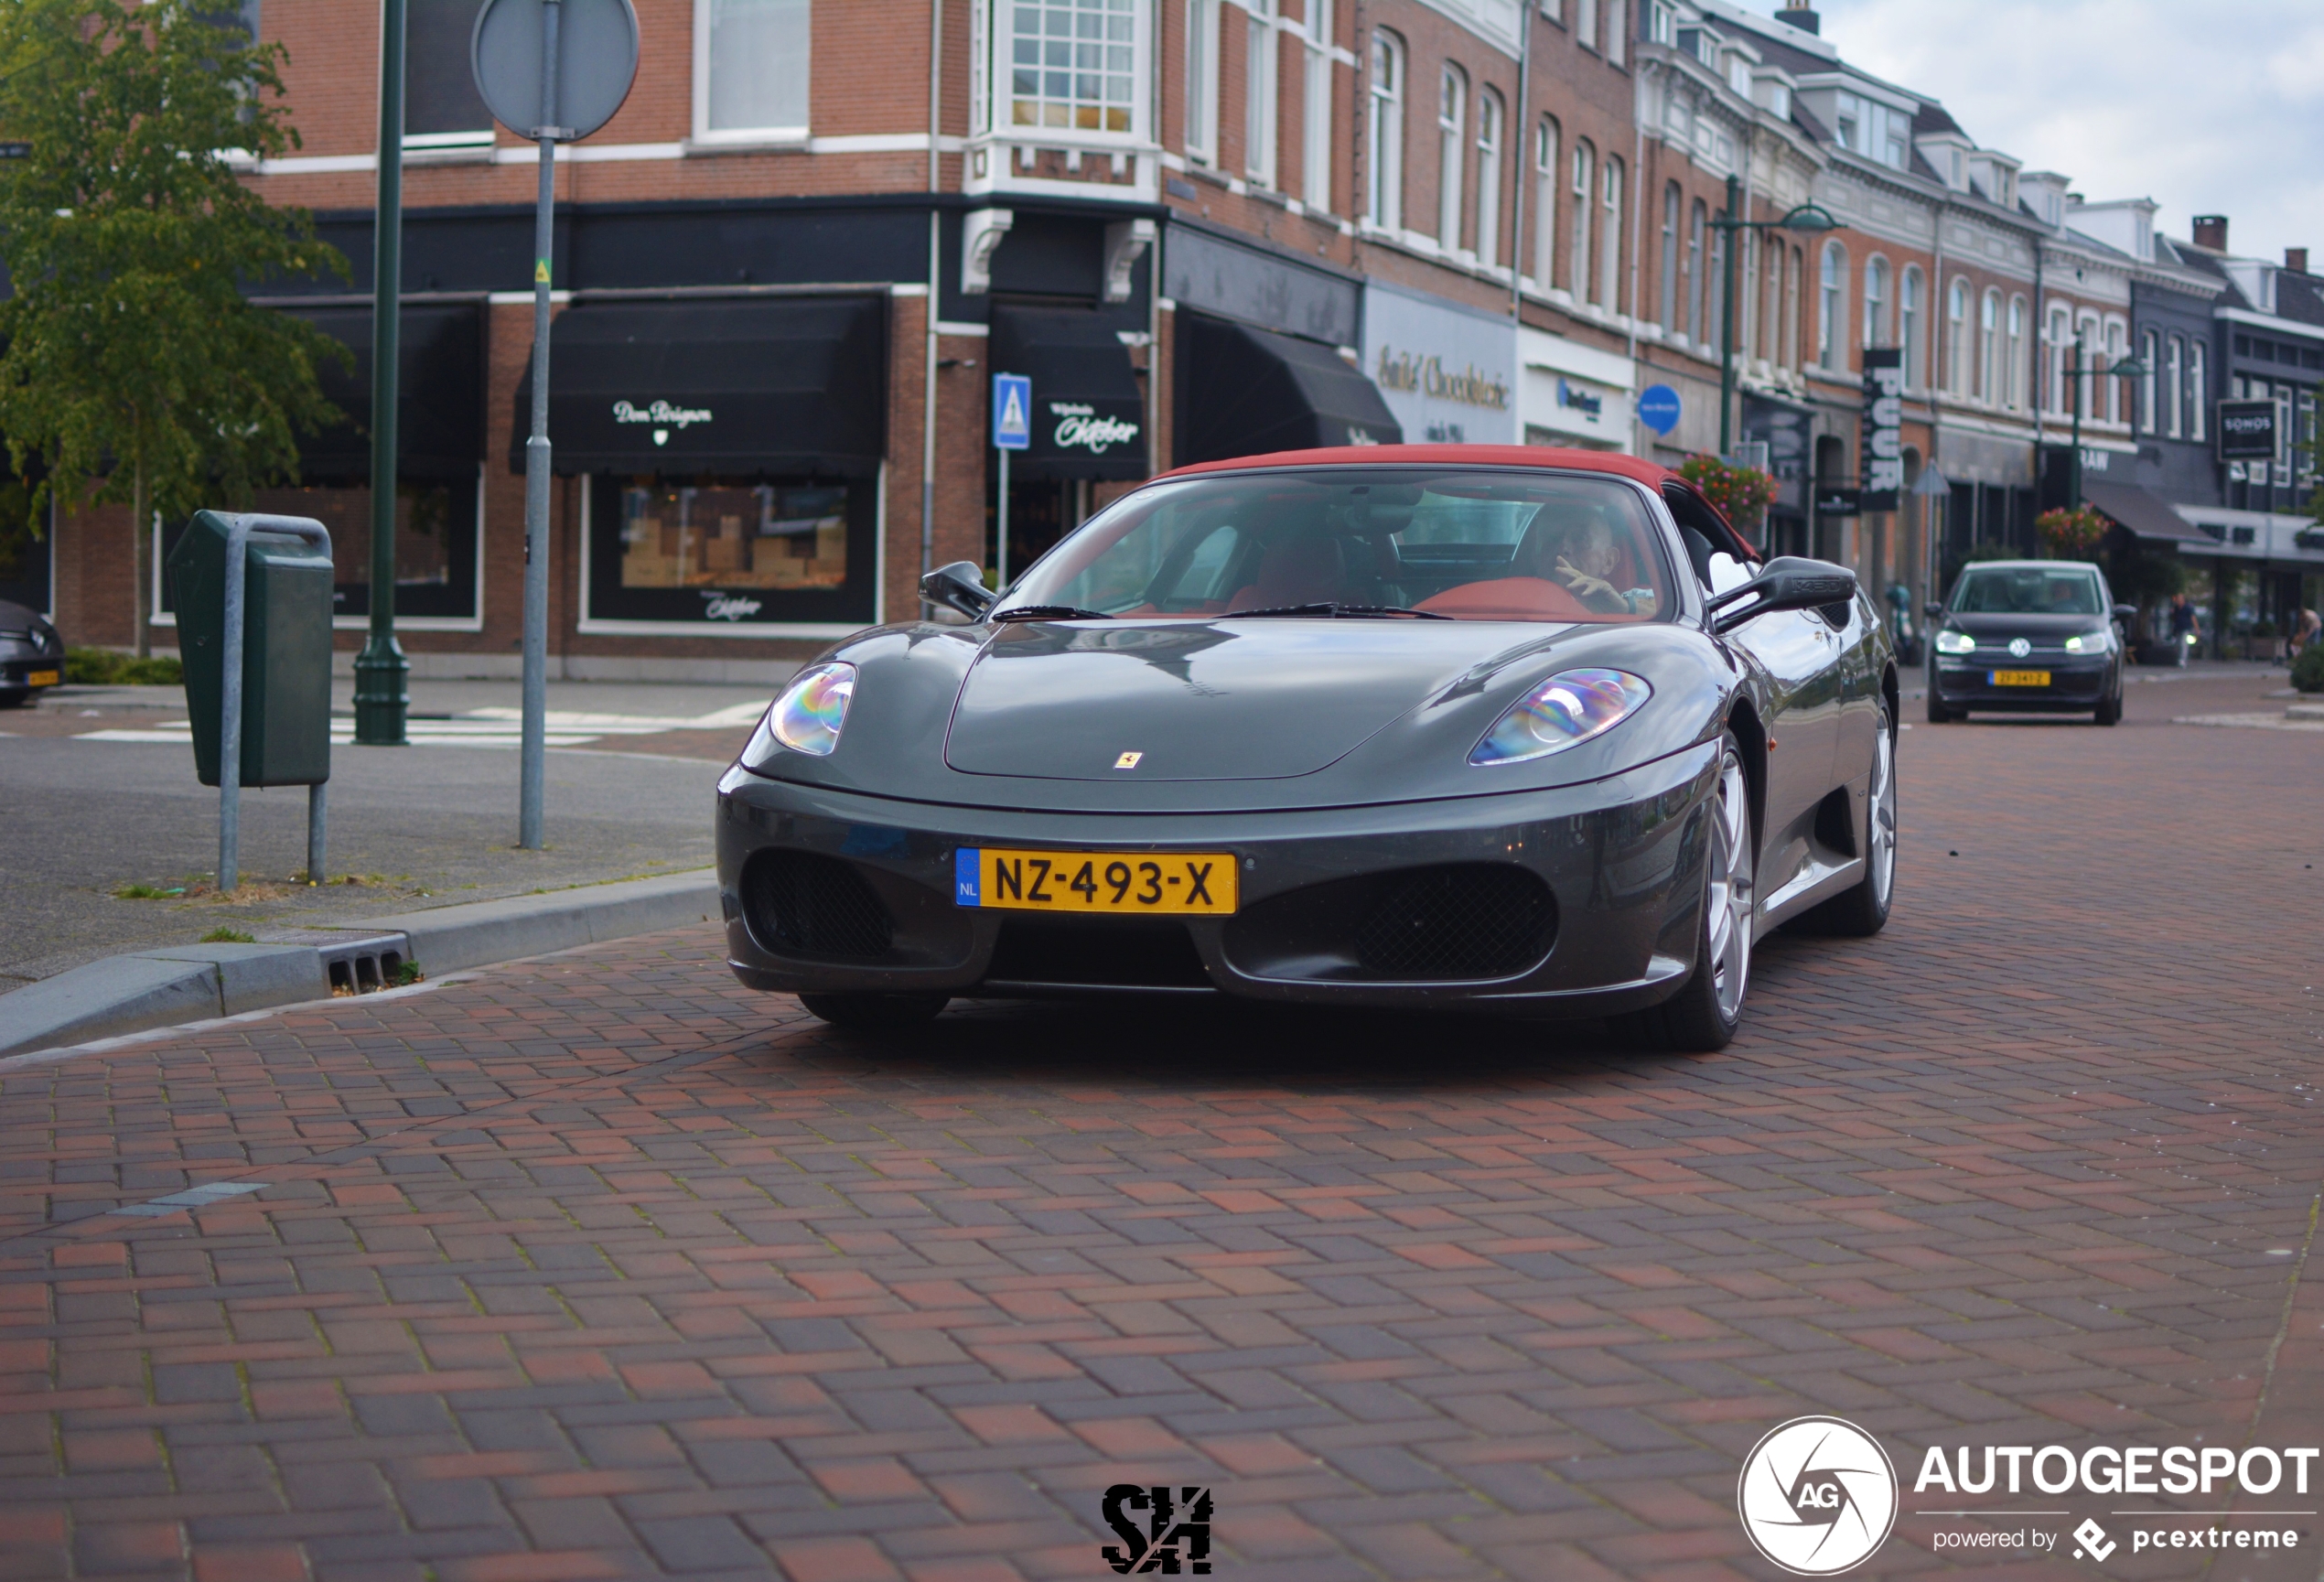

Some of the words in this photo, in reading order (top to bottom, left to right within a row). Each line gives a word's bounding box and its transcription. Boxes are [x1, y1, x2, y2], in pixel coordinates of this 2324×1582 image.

[612, 400, 651, 423] Dom
[1871, 367, 1900, 492] PUUR
[2224, 416, 2272, 431] SONOS
[1054, 414, 1138, 454] Oktober
[960, 882, 977, 896] NL
[995, 857, 1214, 906] NZ-493-X
